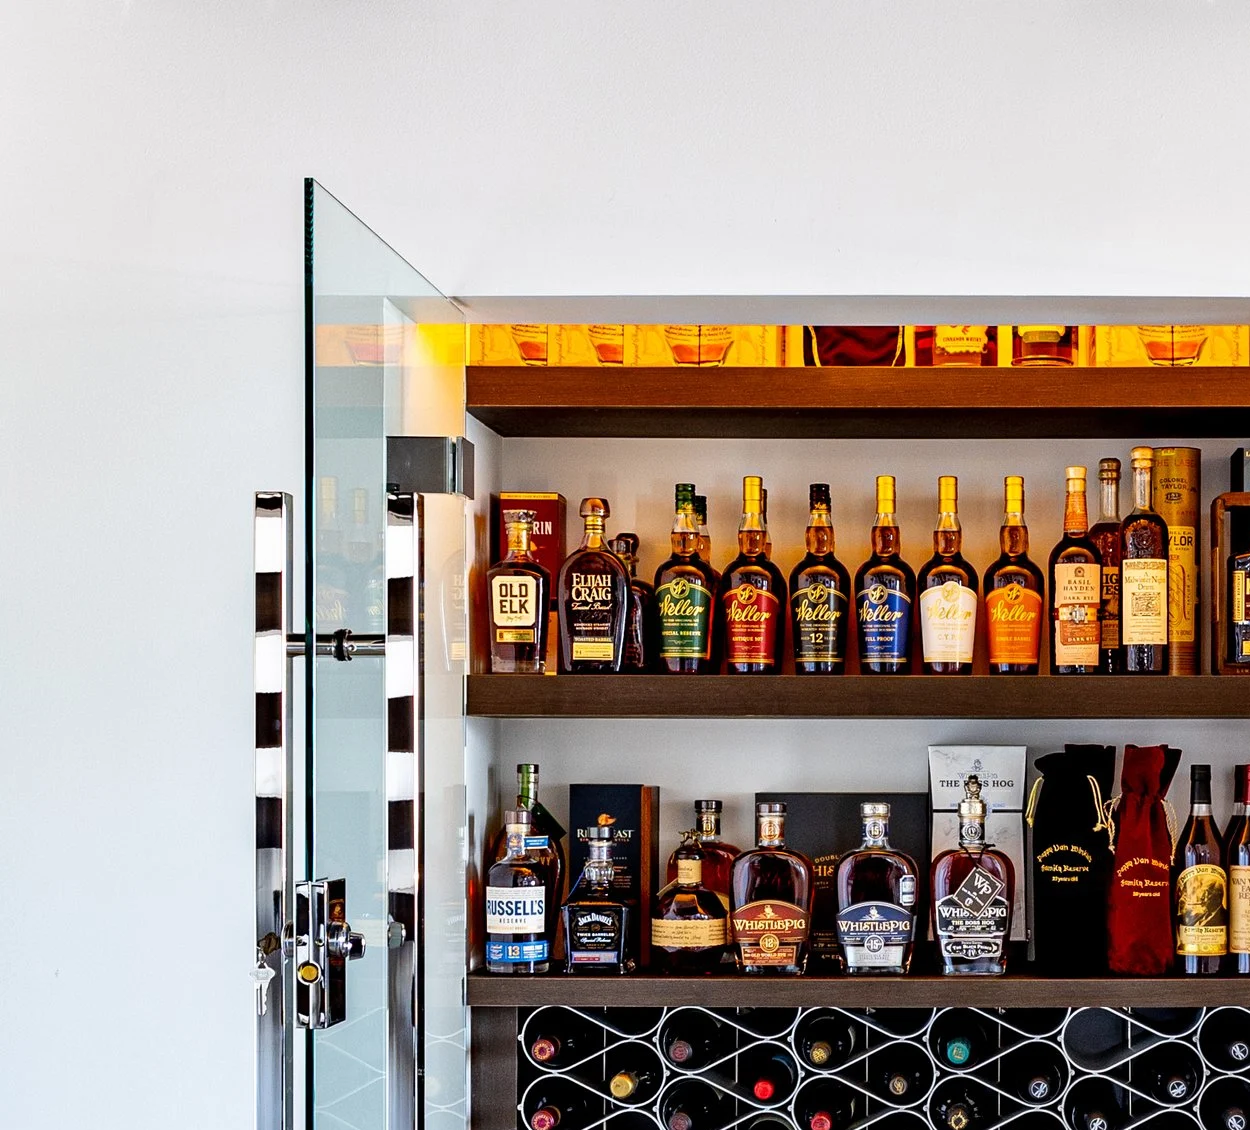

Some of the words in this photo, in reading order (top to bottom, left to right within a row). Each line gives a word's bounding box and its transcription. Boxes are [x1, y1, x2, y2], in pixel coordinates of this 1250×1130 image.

[572, 573, 612, 588] ELIJAH
[499, 583, 528, 598] OLD
[571, 586, 612, 603] CRAIG
[499, 599, 529, 614] ELK
[658, 594, 705, 616] Weller
[726, 599, 771, 622] Weller
[794, 599, 842, 622] Weller
[858, 599, 904, 622] Weller
[927, 599, 972, 621] Weller
[991, 599, 1037, 622] Weller
[809, 632, 824, 644] 12
[939, 779, 960, 788] THE
[992, 779, 1014, 788] HOG
[1231, 877, 1247, 886] VAN
[487, 899, 544, 916] RUSSELL'S
[499, 917, 527, 925] RESERVE
[578, 914, 592, 926] JACK
[507, 945, 520, 956] 13
